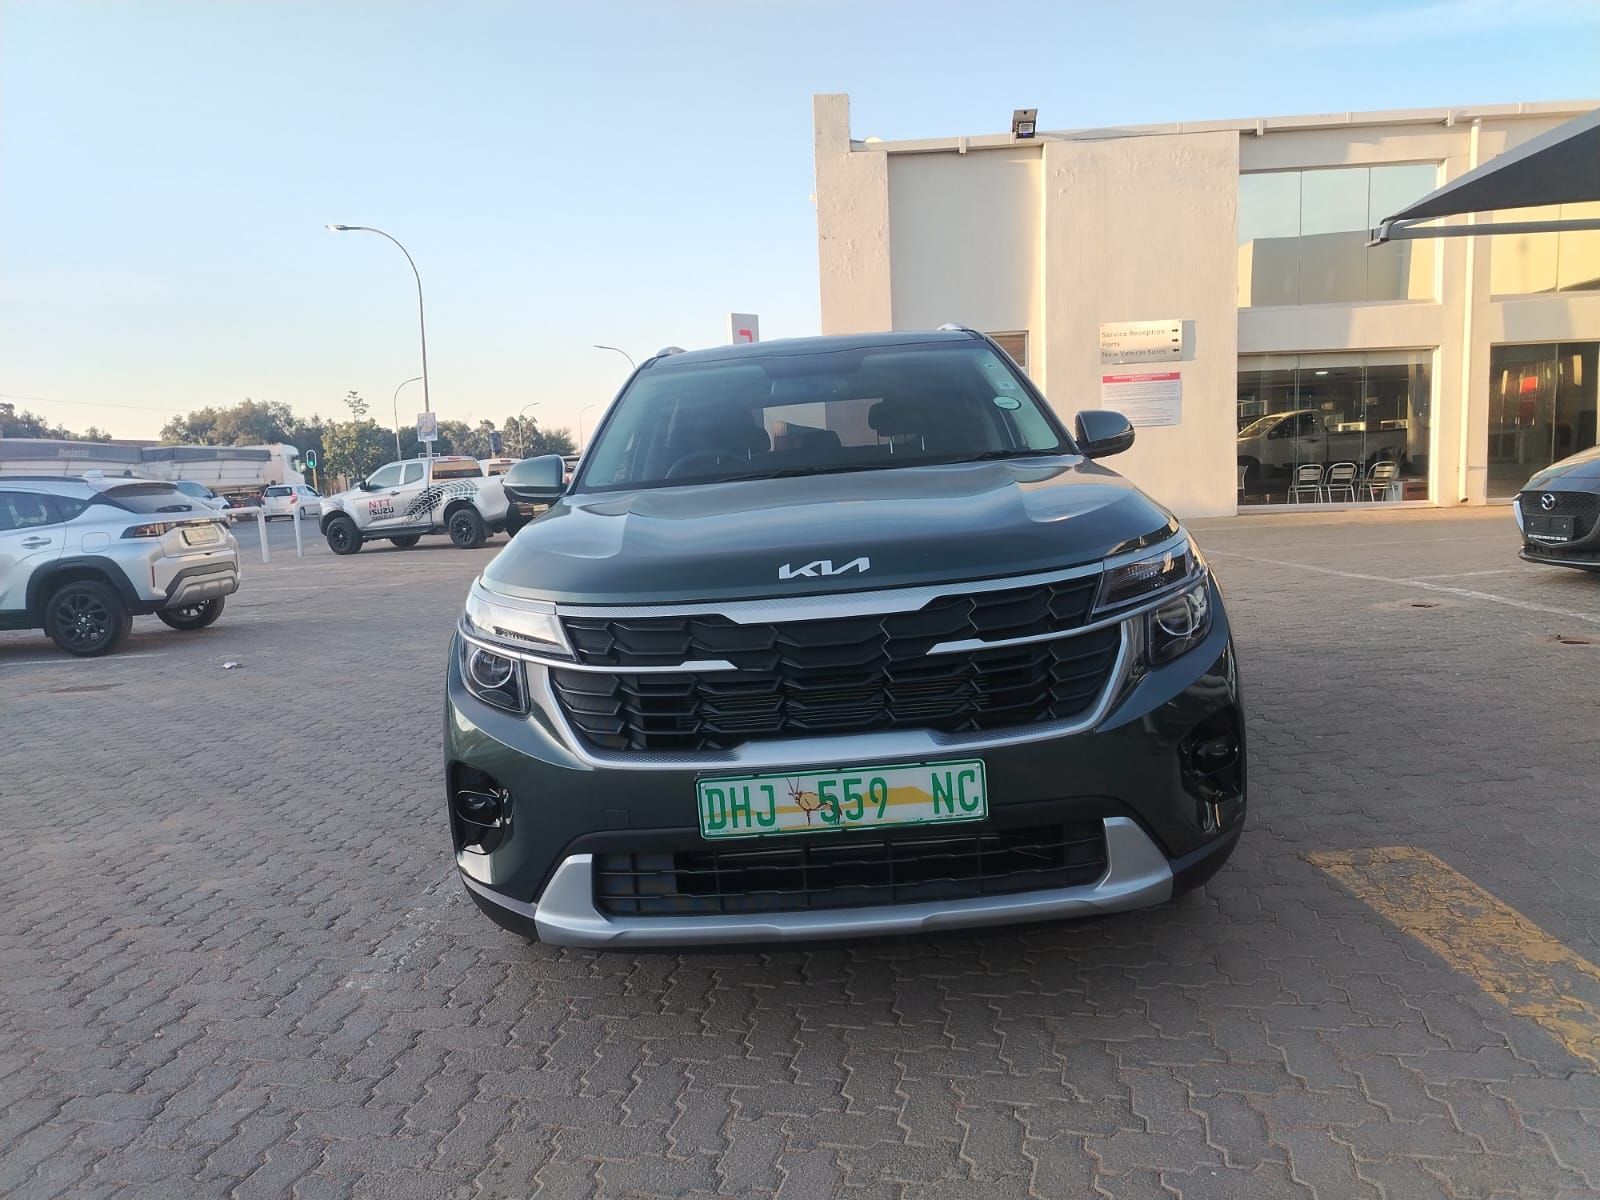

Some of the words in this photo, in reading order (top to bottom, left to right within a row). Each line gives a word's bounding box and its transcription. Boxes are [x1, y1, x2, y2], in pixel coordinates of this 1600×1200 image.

[1129, 329, 1166, 337] Reception
[1101, 350, 1118, 358] New
[368, 498, 391, 508] NTT
[369, 506, 394, 515] ISUZU
[779, 557, 870, 579] KIA
[704, 784, 777, 830] DHJ
[817, 776, 888, 823] 559
[931, 769, 979, 815] NC
